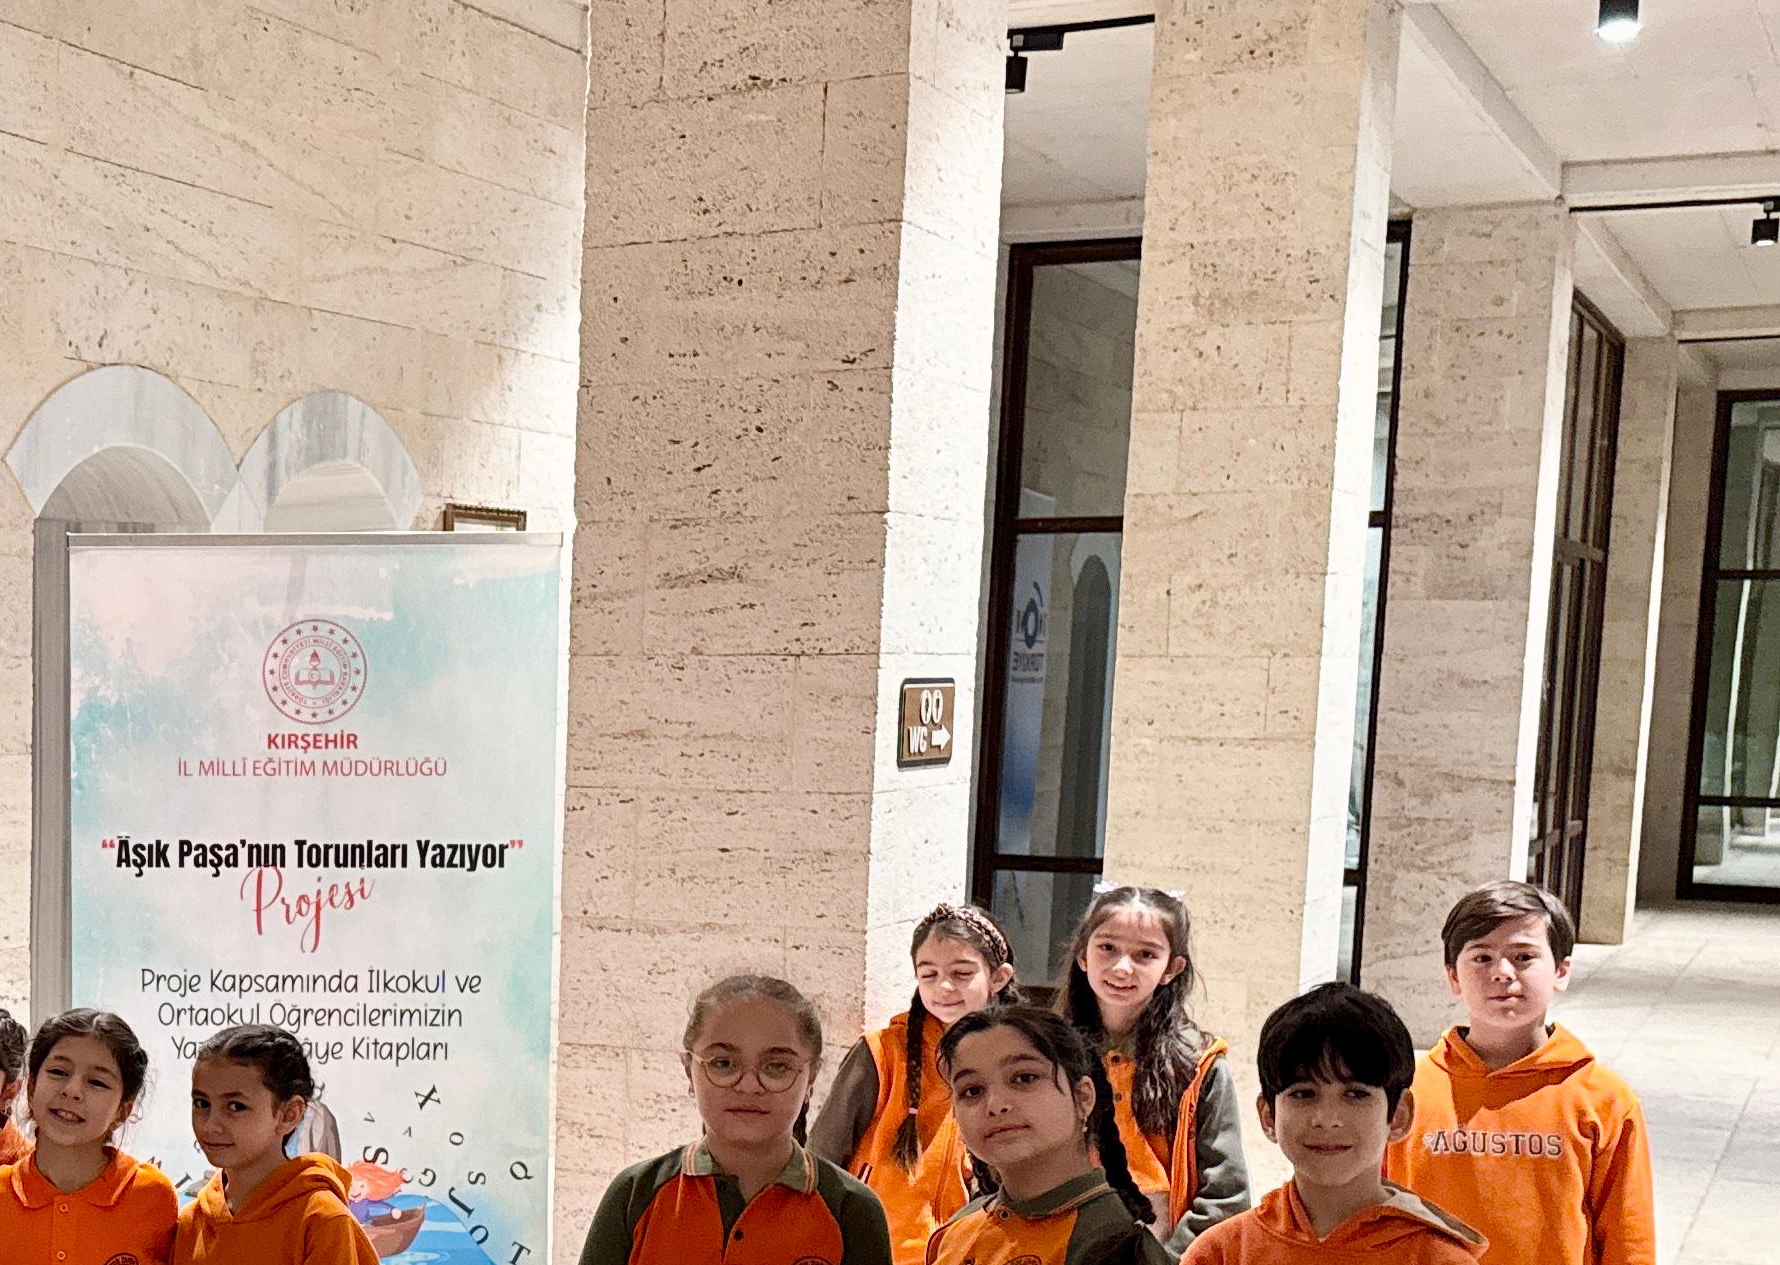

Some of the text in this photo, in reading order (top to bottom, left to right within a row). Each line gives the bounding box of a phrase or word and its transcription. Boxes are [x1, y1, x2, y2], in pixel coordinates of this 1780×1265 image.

[267, 729, 358, 754] KIRŞEHİR
[177, 756, 193, 777] İL
[252, 756, 316, 777] EĞİTİM
[321, 756, 448, 777] MÜDÜRLÜĞÜ
[294, 839, 408, 869] Torunları
[241, 864, 375, 953] Projesi
[141, 965, 482, 998] Proje Kapsamında İlkokul ve
[158, 999, 463, 1034] Ortaokul Öğrencilerimizin
[352, 1036, 448, 1067] Kitapları
[414, 1084, 441, 1110] X
[362, 1146, 389, 1165] S
[418, 1168, 437, 1187] G
[510, 1161, 534, 1180] Q
